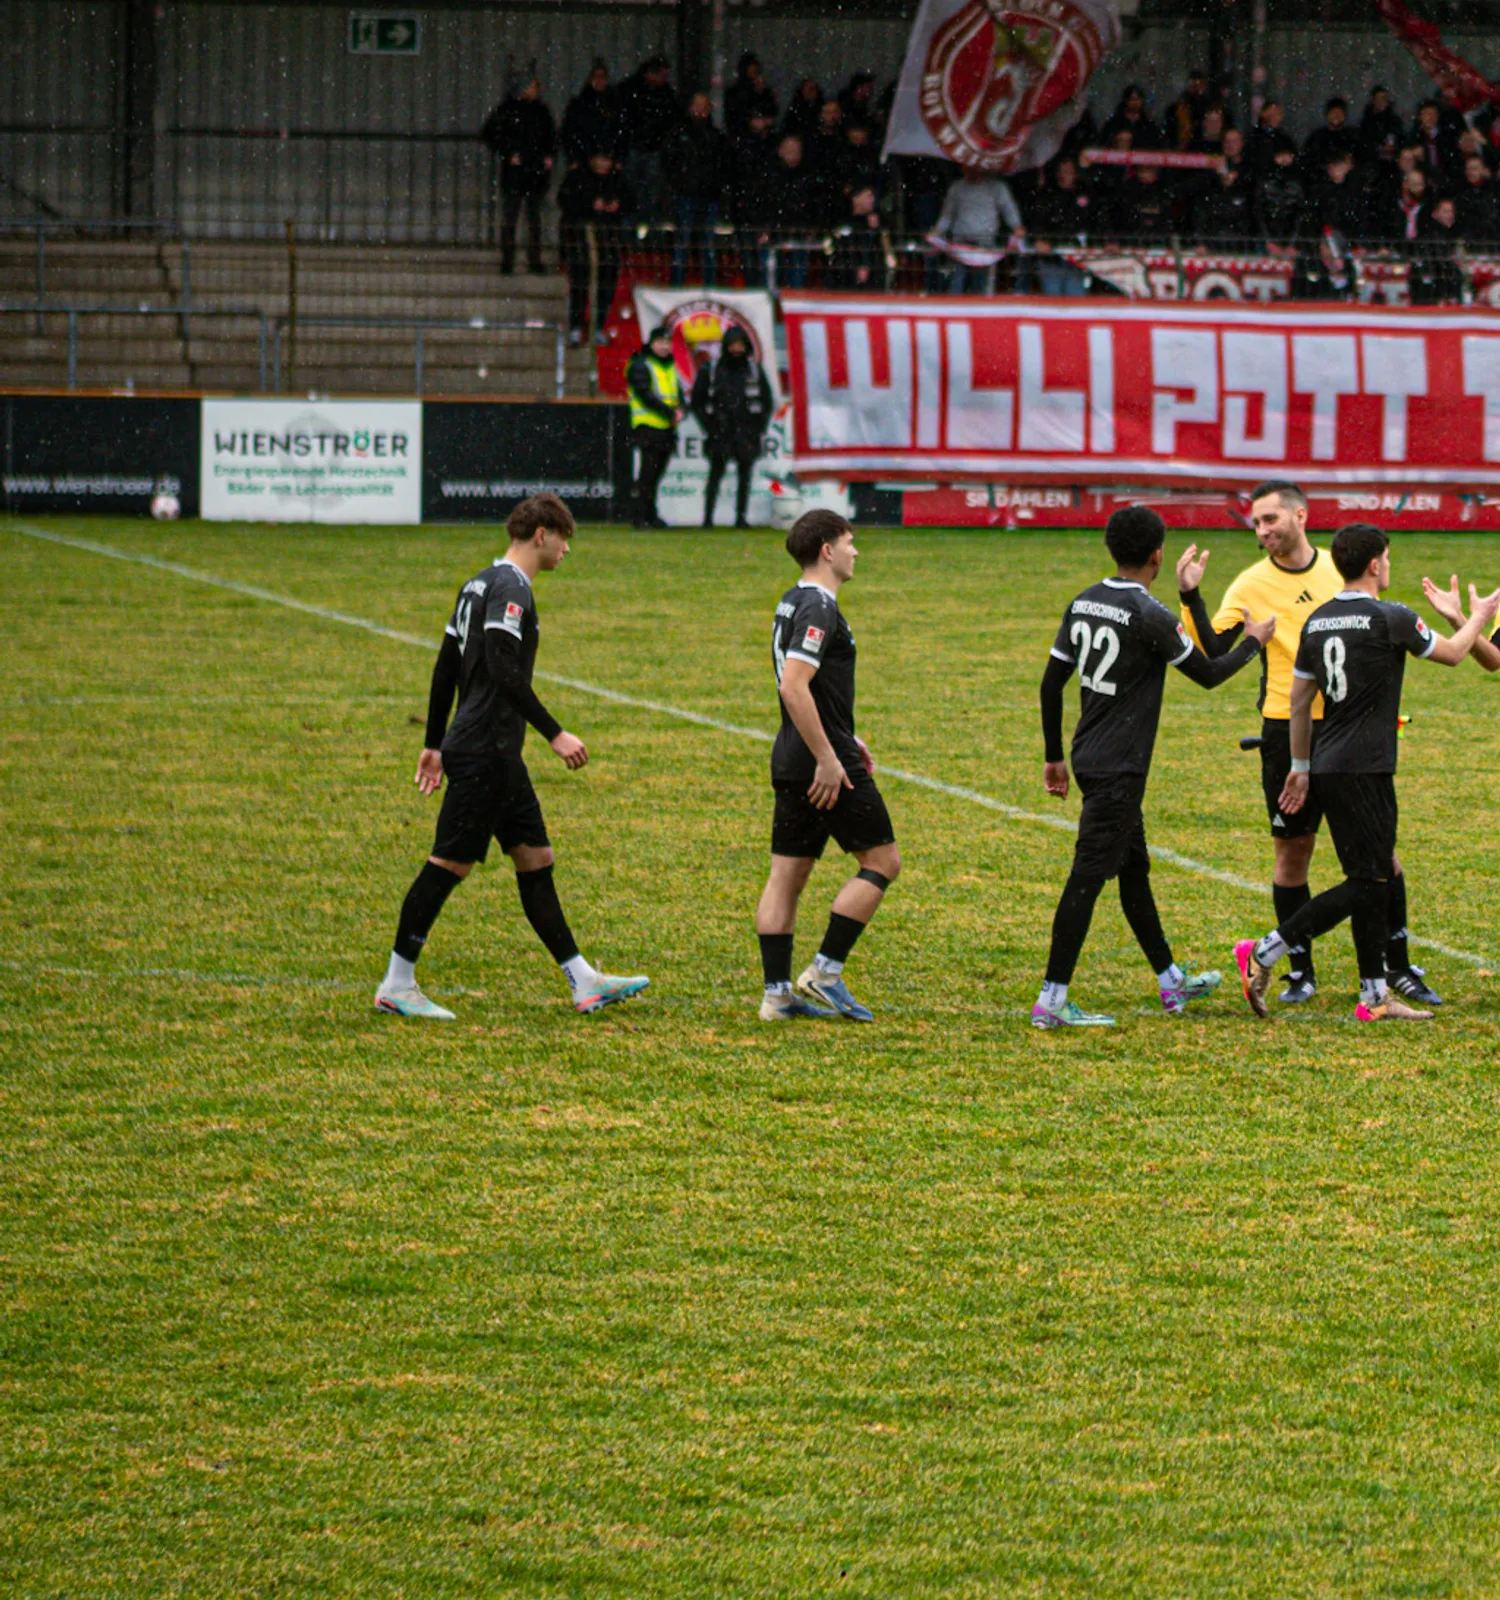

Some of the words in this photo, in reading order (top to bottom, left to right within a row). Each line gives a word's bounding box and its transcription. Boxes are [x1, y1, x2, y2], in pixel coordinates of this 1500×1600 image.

[801, 320, 1115, 452] WILLI
[1151, 328, 1428, 462] POTT
[213, 430, 409, 457] WIENSTRÖER
[1011, 490, 1070, 508] AHLEN
[1070, 621, 1120, 696] 22
[1323, 636, 1347, 702] 8
